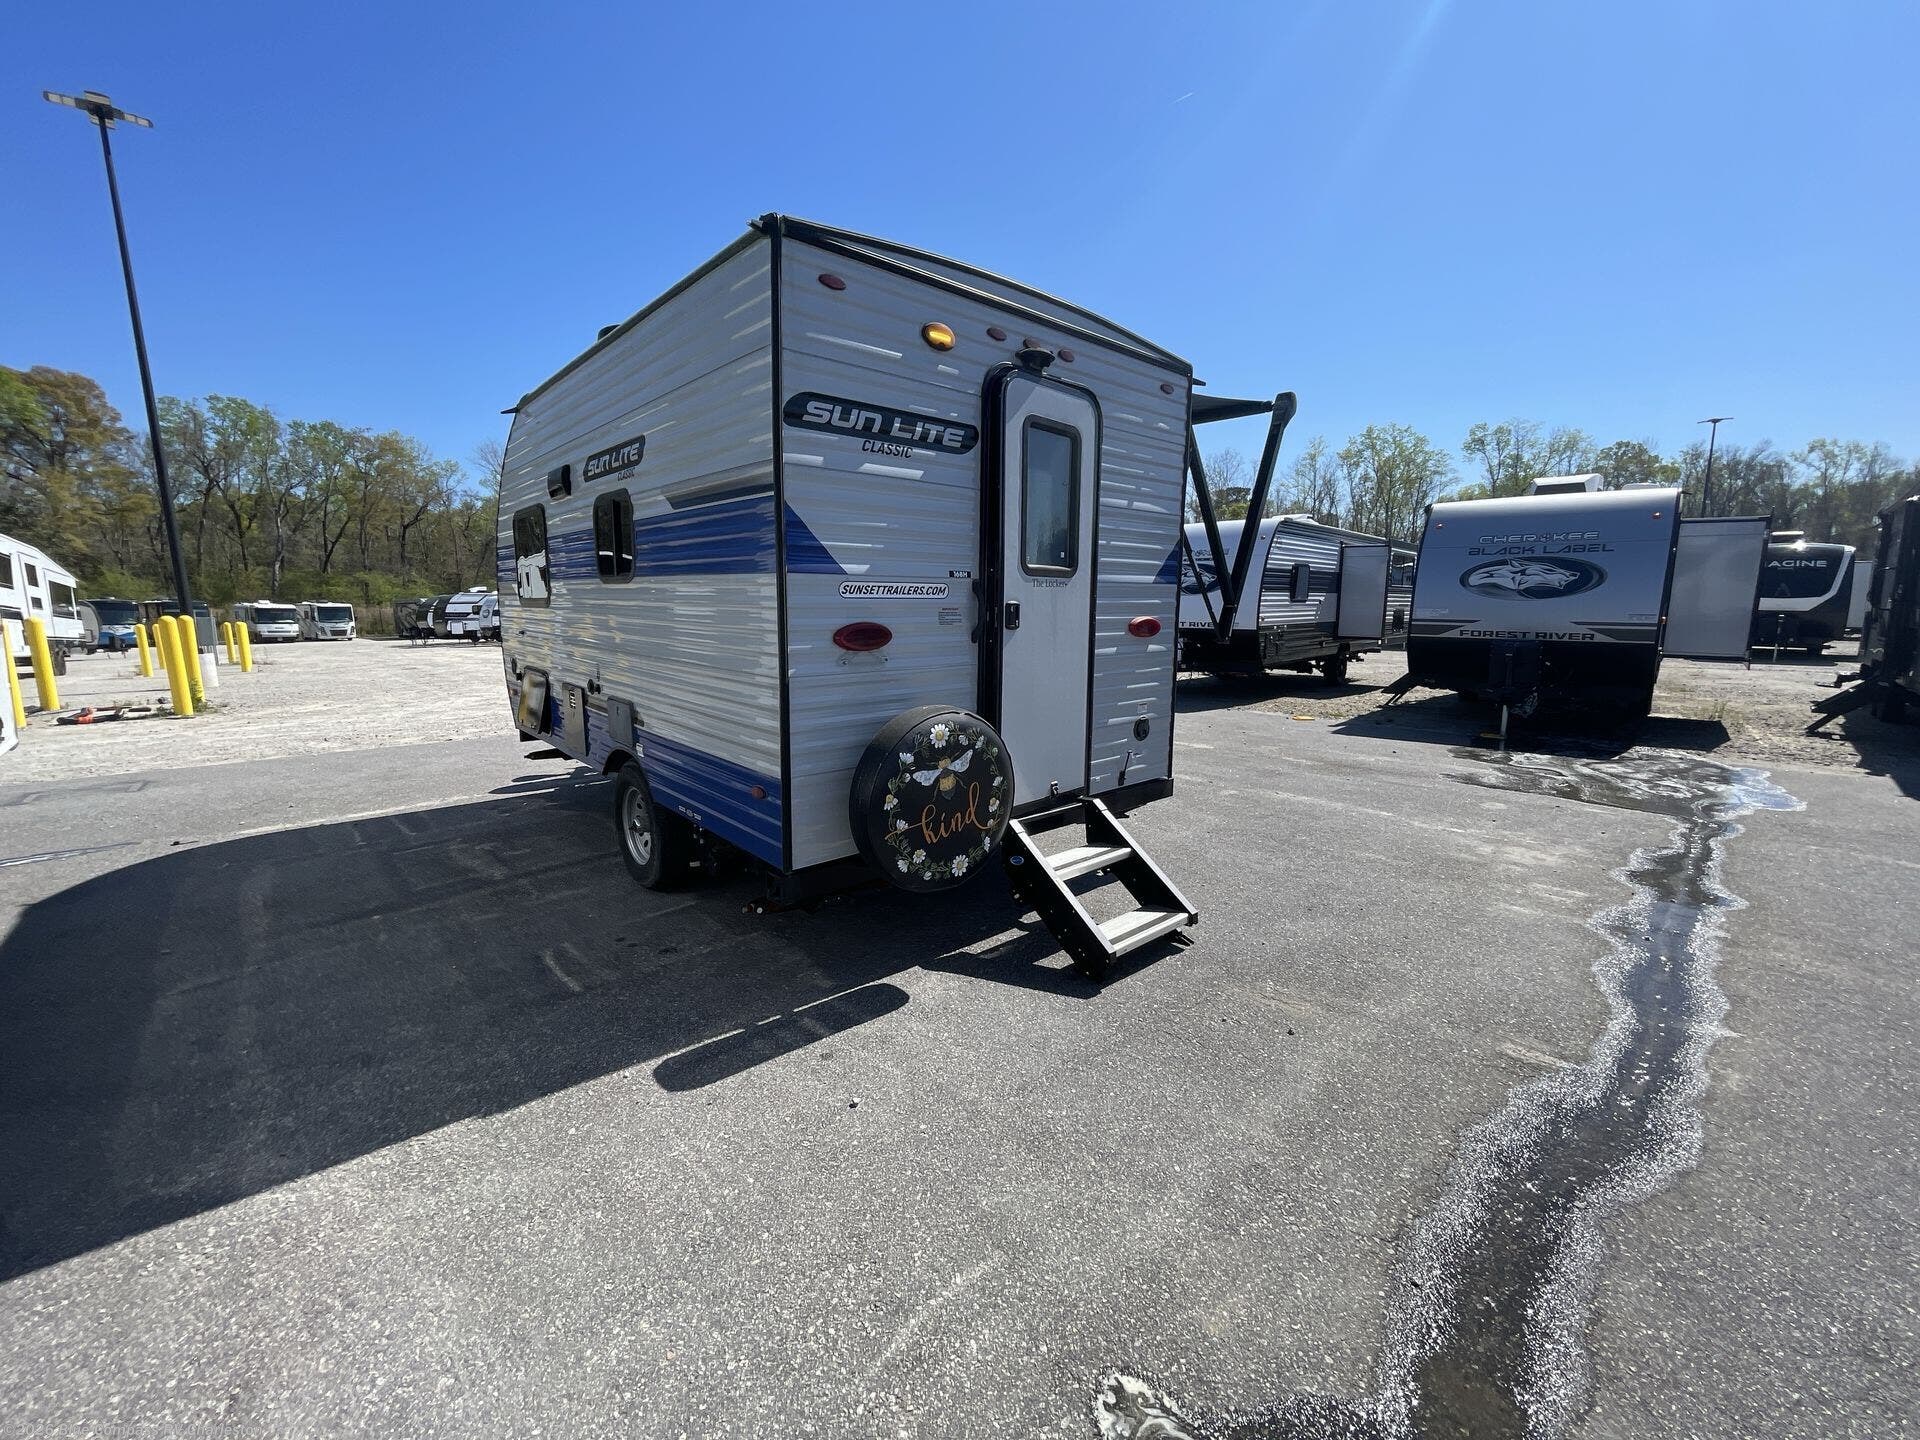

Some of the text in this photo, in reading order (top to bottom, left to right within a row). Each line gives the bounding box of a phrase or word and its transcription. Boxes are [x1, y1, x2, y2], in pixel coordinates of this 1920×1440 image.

[802, 400, 966, 448] SUN LITE
[861, 439, 913, 459] CLASSIC
[587, 442, 640, 476] SUN LITE
[1468, 543, 1615, 556] BLACK LABEL
[1764, 560, 1828, 568] AGINE
[841, 584, 947, 597] SUNSETTRAILERS.COM
[1459, 629, 1595, 641] FOREST RIVER
[885, 782, 999, 845] kind
